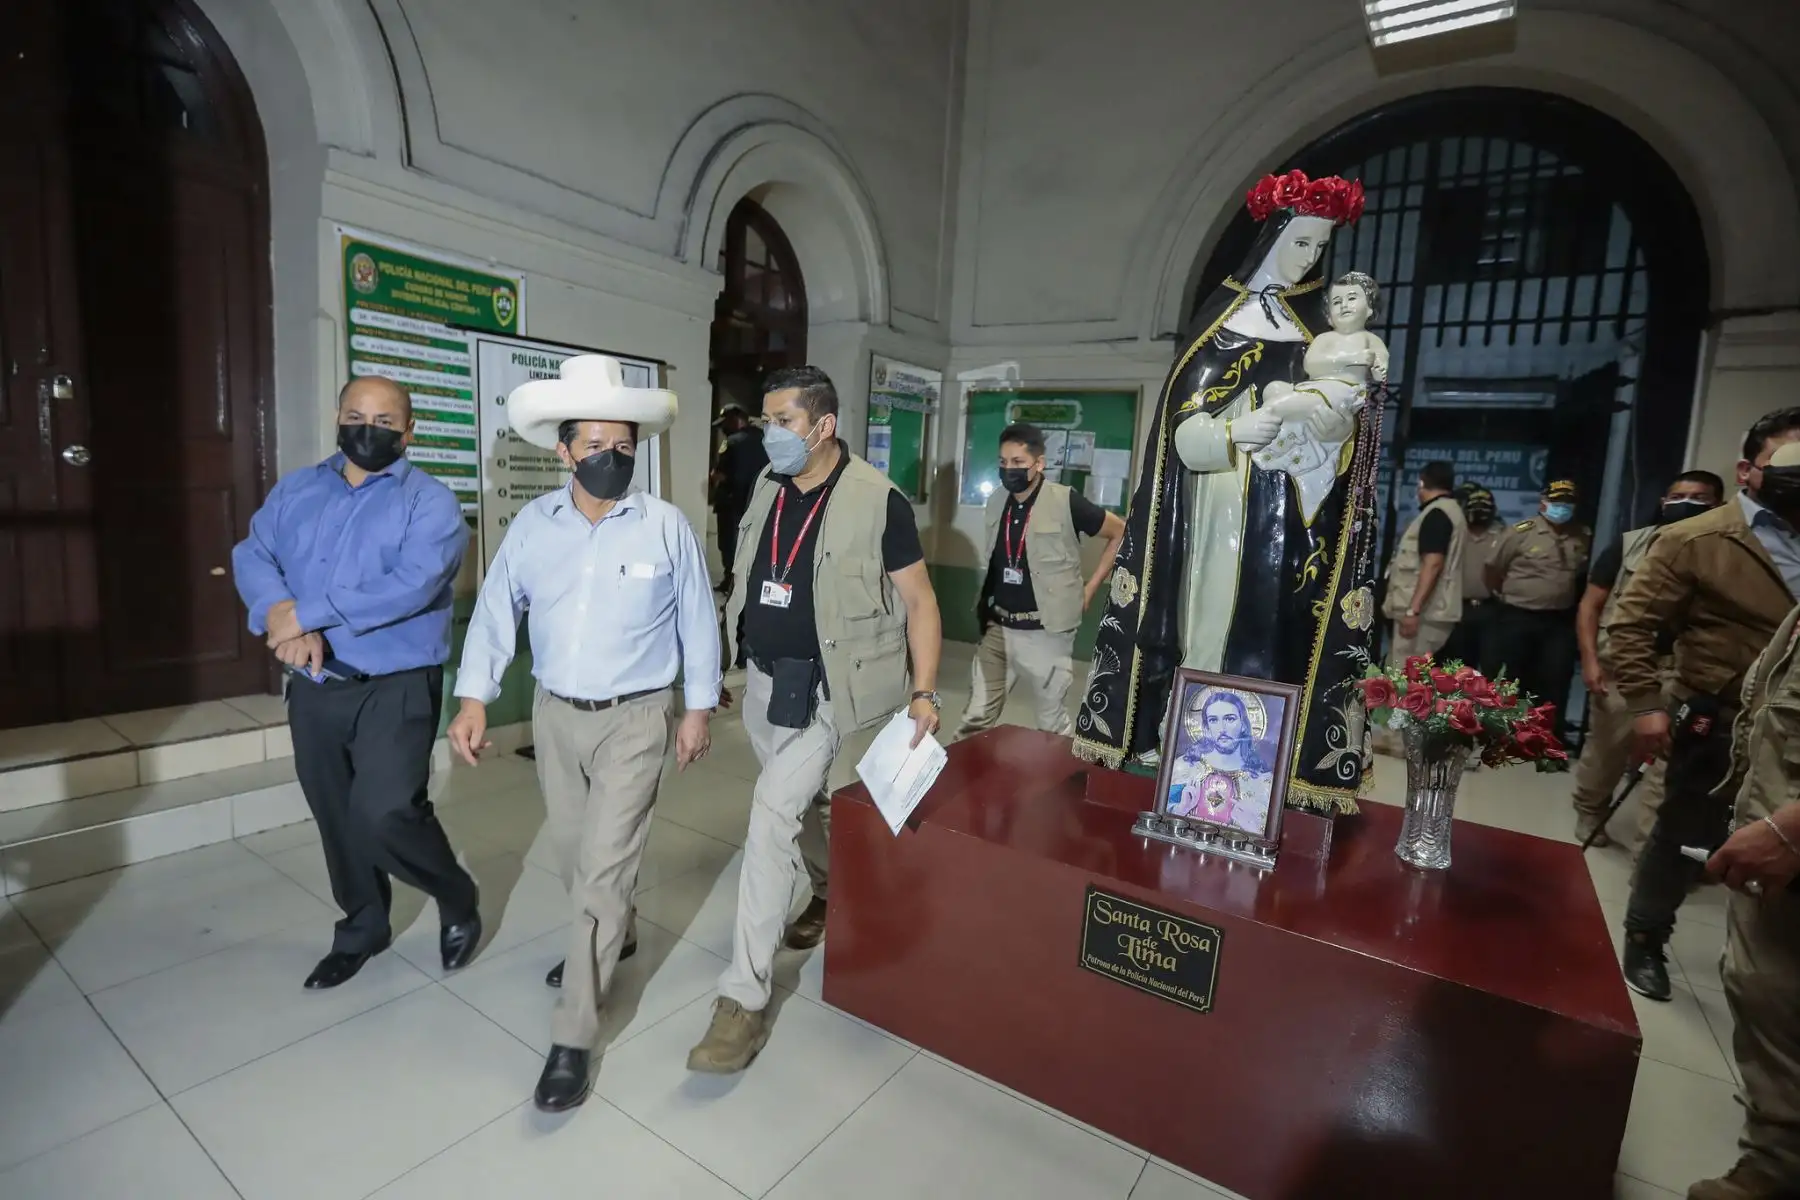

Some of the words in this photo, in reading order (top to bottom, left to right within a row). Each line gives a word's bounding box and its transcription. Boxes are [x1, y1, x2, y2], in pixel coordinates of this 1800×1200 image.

[414, 270, 454, 289] NACIONAL
[456, 280, 471, 293] DEL
[512, 353, 547, 369] POLICÍA
[1093, 900, 1150, 933] Santa
[1157, 920, 1210, 953] Rosa
[1118, 933, 1177, 972] Lima
[1142, 936, 1158, 950] de
[1111, 962, 1119, 973] de
[1120, 965, 1126, 976] la
[1149, 977, 1177, 995] Nacional
[1177, 987, 1188, 999] del
[1188, 991, 1205, 1005] Perú
